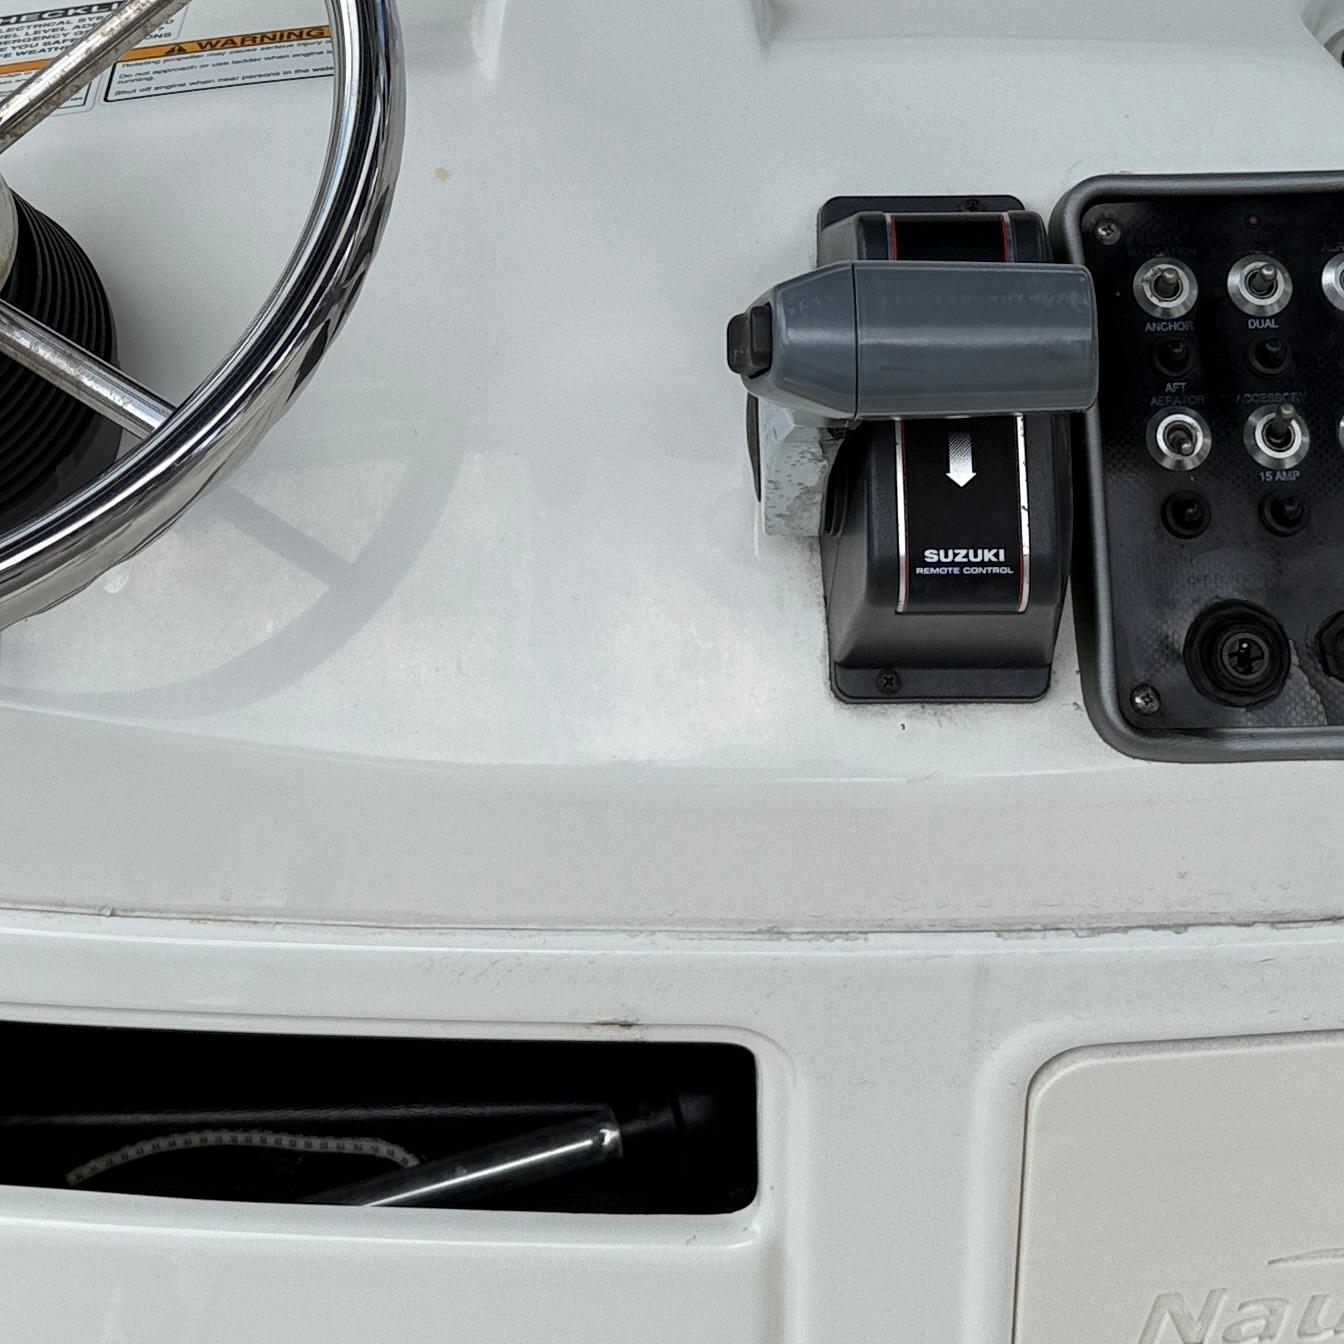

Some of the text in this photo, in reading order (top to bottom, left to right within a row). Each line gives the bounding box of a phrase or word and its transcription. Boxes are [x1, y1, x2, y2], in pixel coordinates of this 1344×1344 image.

[196, 28, 325, 50] WARNING
[311, 64, 333, 74] wate
[1144, 320, 1194, 333] ANCHOR
[1247, 318, 1280, 330] DUAL
[1164, 382, 1187, 393] AFT
[1259, 470, 1301, 482] 15 AMP
[923, 548, 1005, 563] SUZUKI
[916, 566, 1014, 575] REMOTE CONTROL
